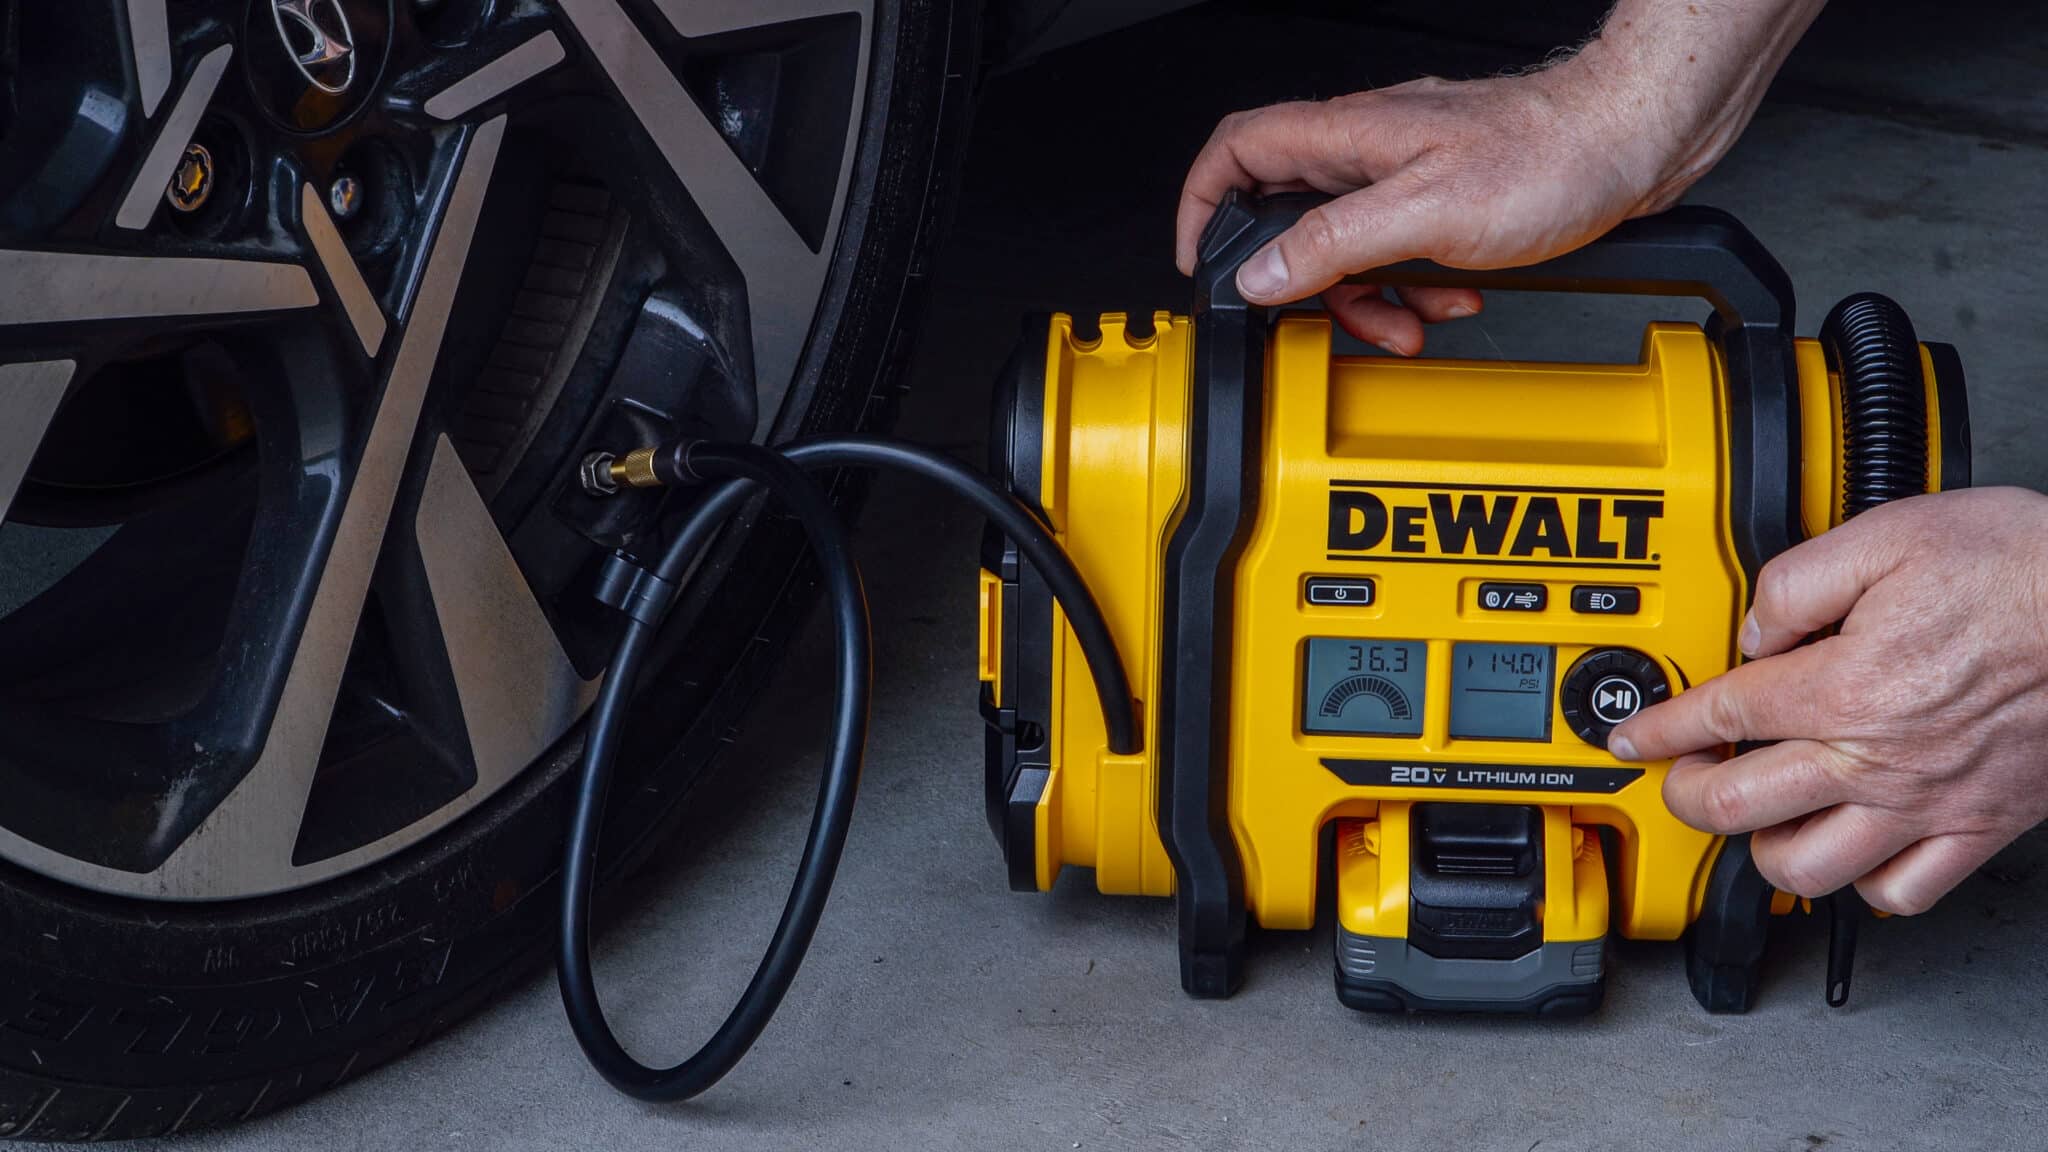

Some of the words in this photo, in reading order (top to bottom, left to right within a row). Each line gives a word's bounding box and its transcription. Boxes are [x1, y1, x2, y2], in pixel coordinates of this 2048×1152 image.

[1348, 645, 1408, 673] 36.3
[1490, 652, 1535, 675] 14.0
[1518, 678, 1540, 690] PSI
[1457, 770, 1536, 785] LITHIUM
[1540, 773, 1575, 786] ION
